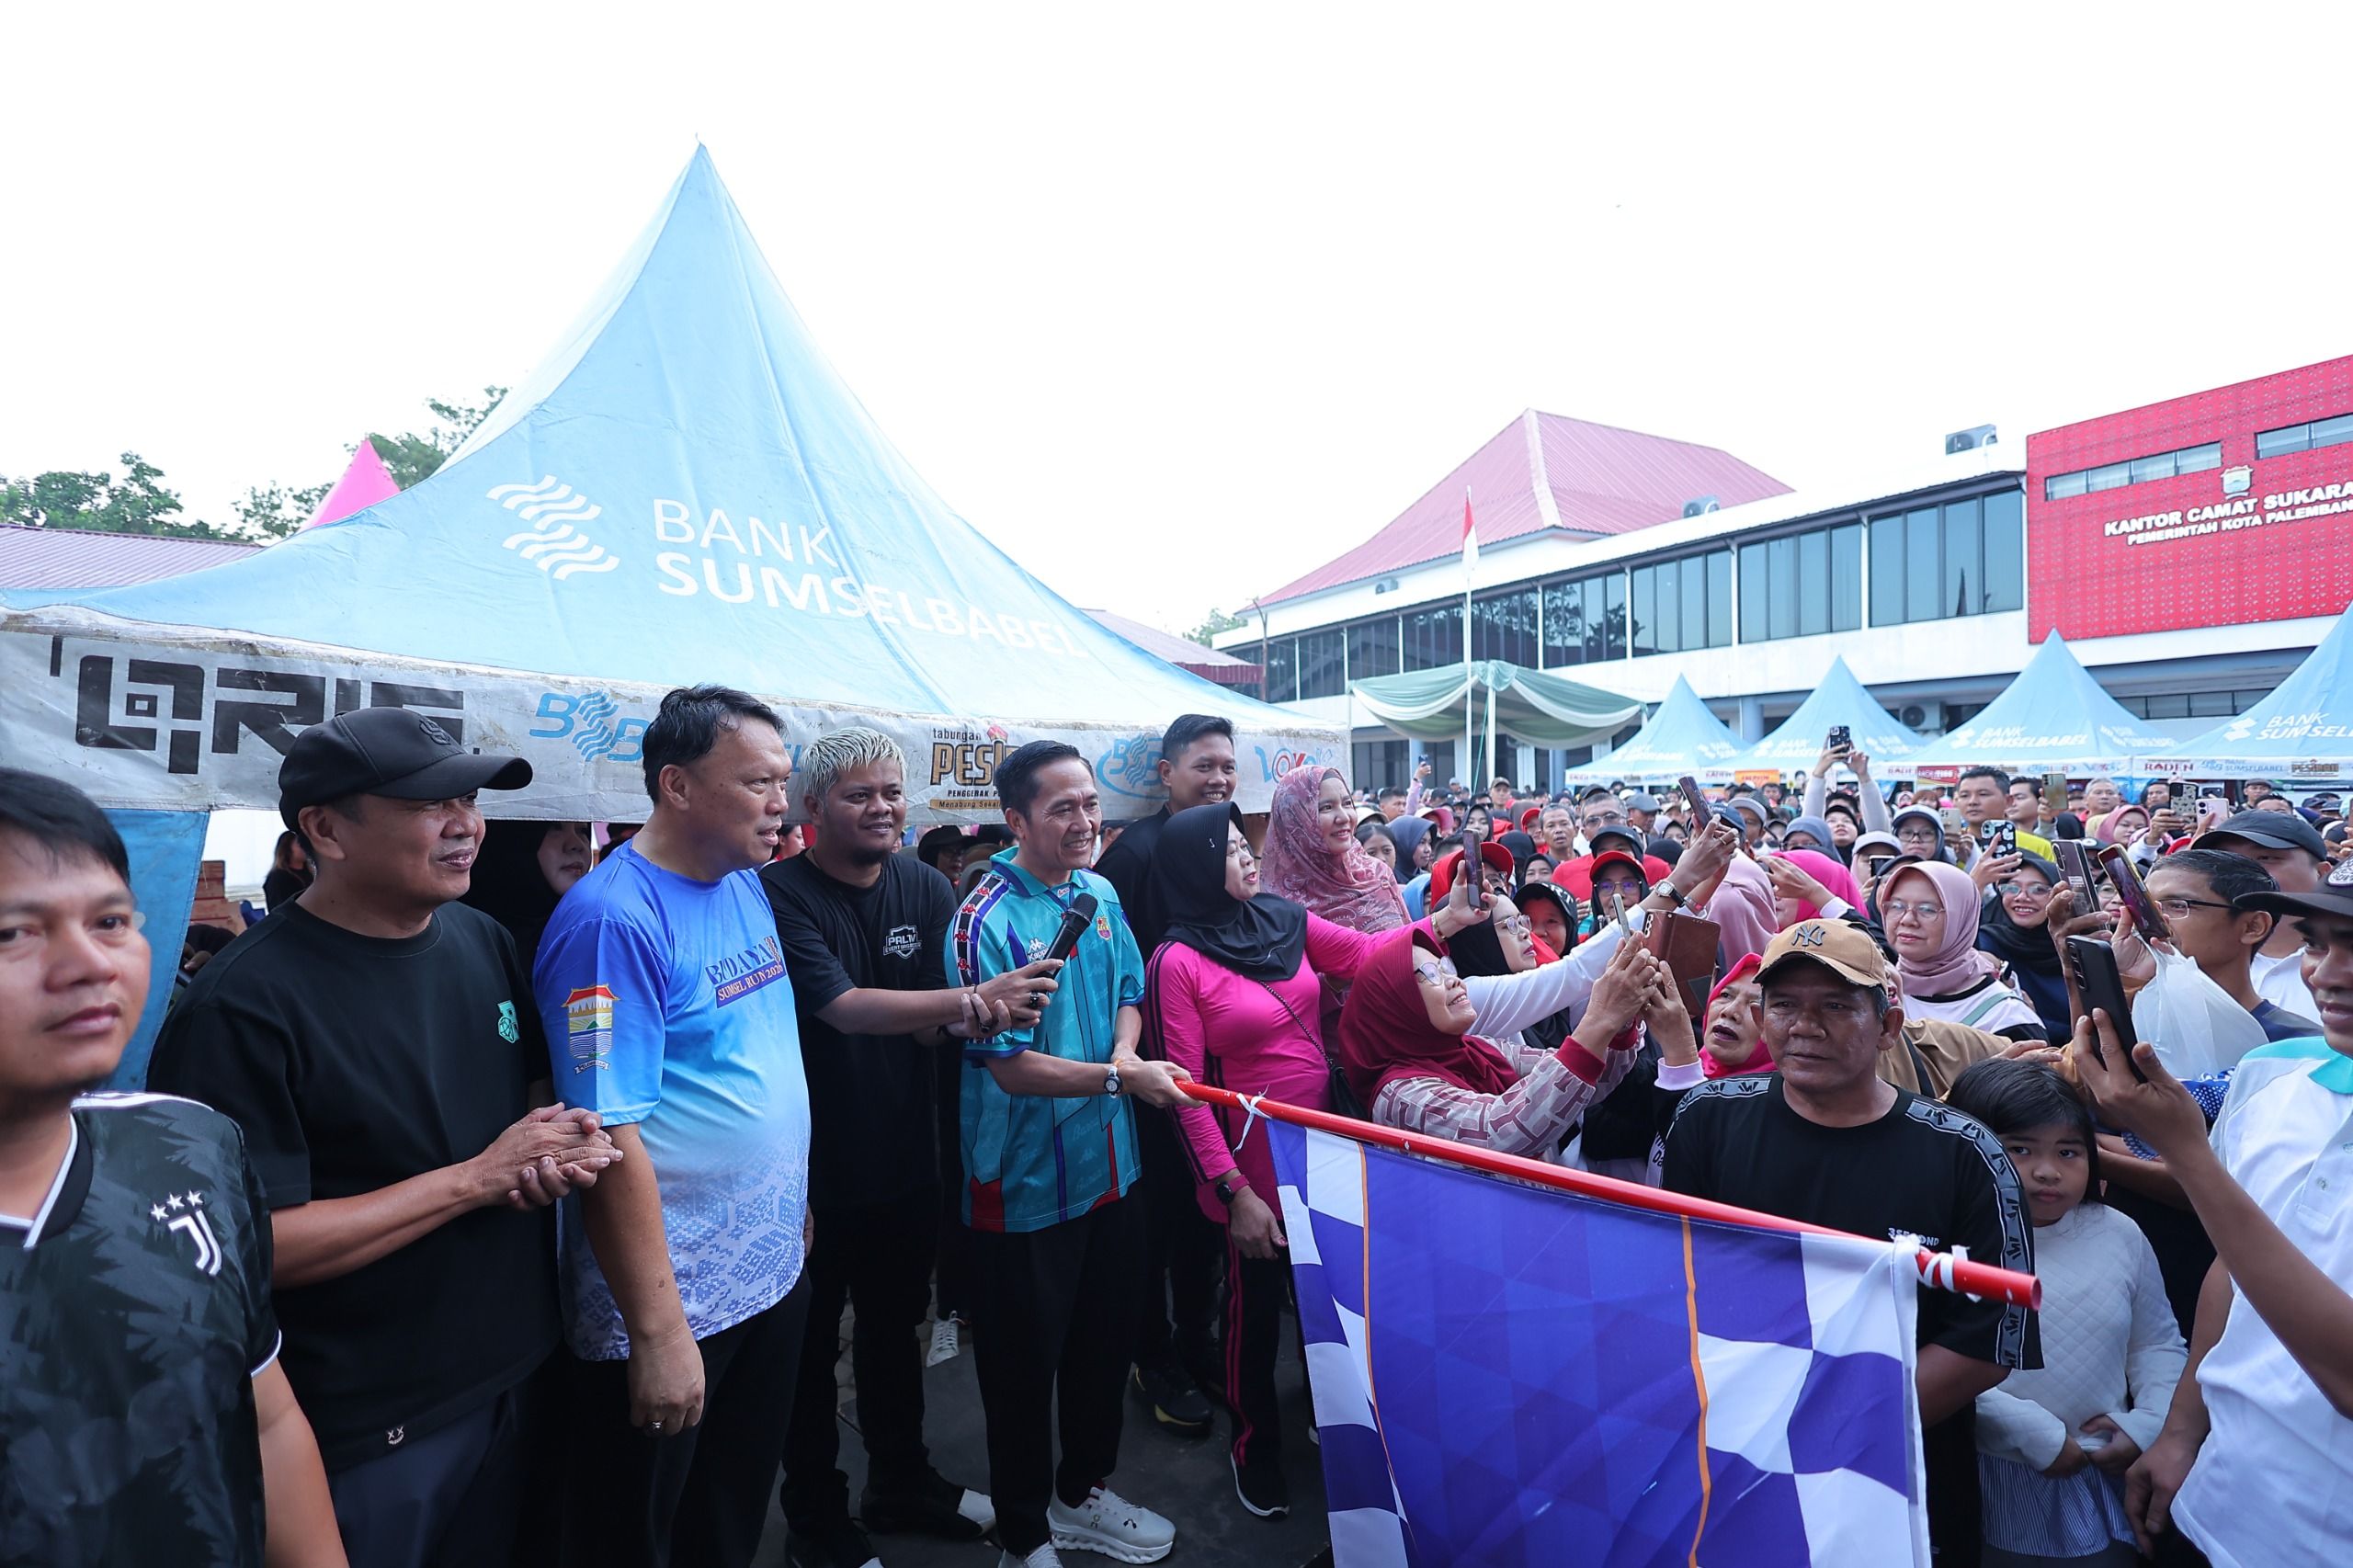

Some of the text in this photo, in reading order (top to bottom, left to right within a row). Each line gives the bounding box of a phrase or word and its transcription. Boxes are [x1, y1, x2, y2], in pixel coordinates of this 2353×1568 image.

[2104, 511, 2183, 537] KANTOR
[2187, 497, 2259, 523] CAMAT
[653, 498, 839, 567] BANK
[2127, 521, 2218, 546] PEMERINTAH
[2221, 514, 2263, 531] KOTA
[655, 551, 1089, 659] SUMSELBABEL
[2266, 712, 2330, 729] BANK
[933, 728, 982, 743] tabungan
[1971, 734, 2088, 749] SUMSELBABEL
[930, 740, 1021, 787] PESI
[948, 790, 989, 798] PENGGERAK
[938, 801, 976, 809] Menabung
[705, 943, 775, 985] BUDAYA
[745, 970, 767, 989] RUN
[1887, 1227, 1939, 1246] 3SEOND
